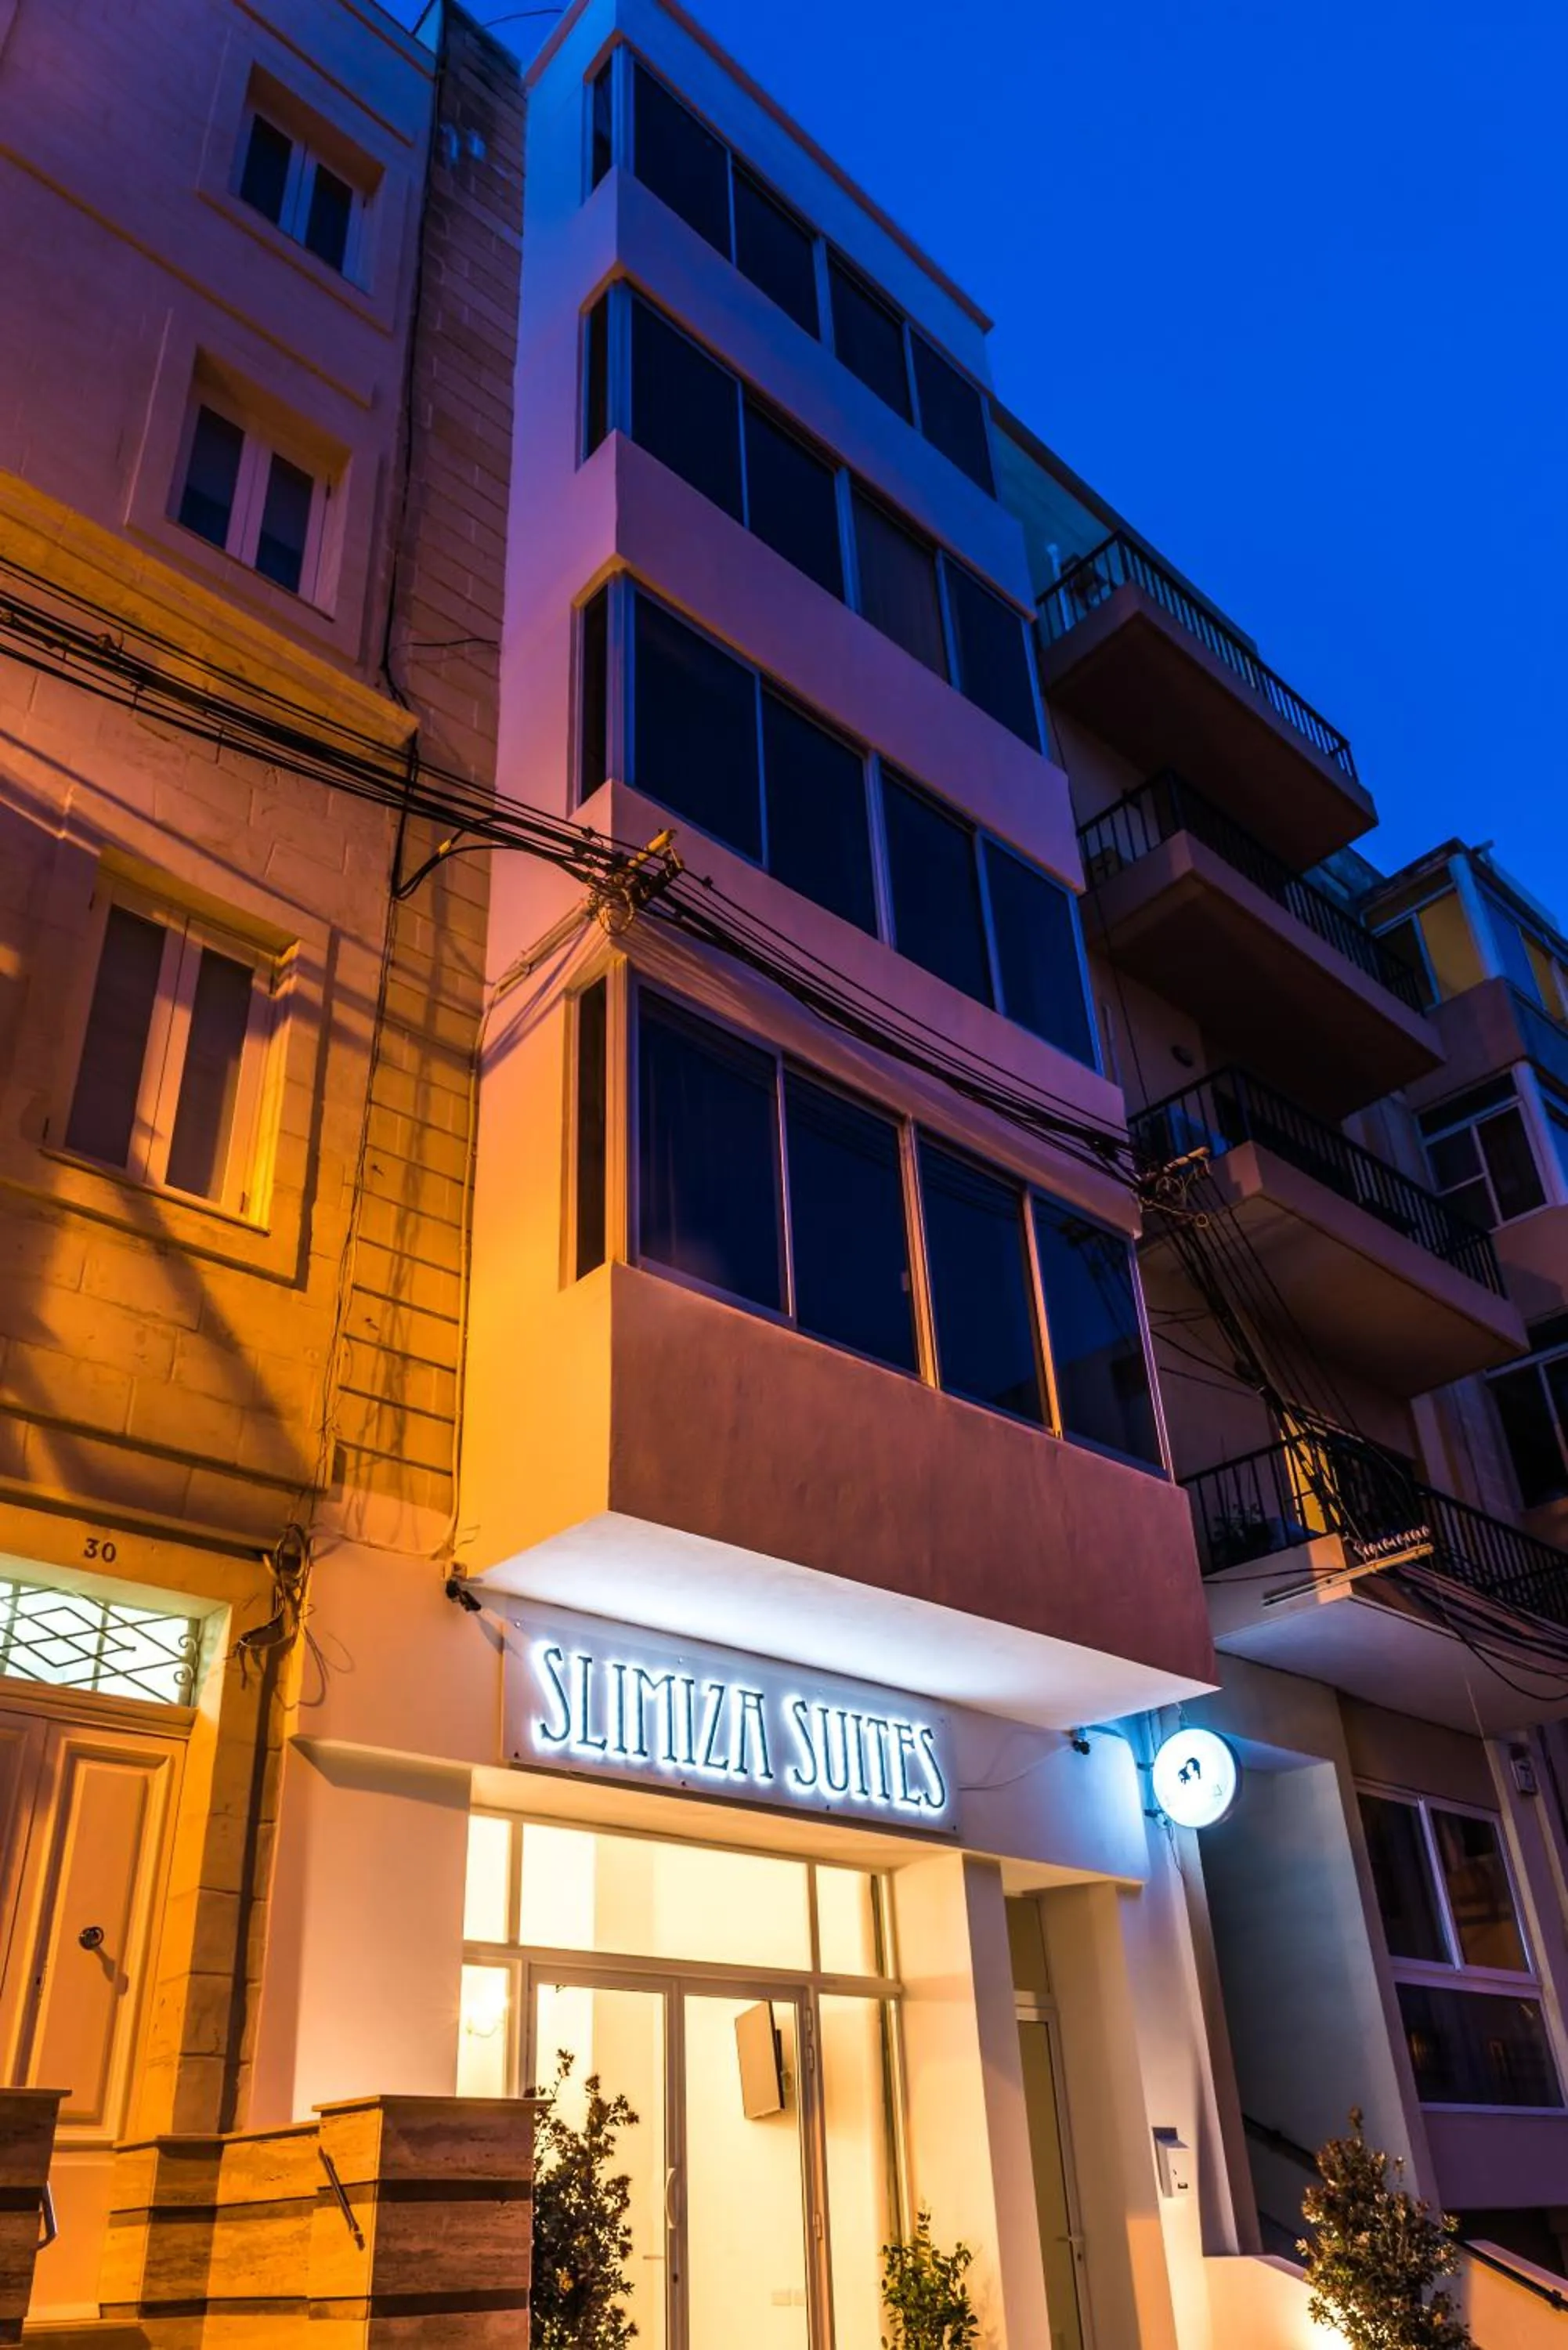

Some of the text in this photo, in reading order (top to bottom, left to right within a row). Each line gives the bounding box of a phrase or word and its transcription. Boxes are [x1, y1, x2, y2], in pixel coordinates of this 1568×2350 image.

[84, 1538, 117, 1564] 30
[539, 1647, 946, 1809] SLIMIZA SUITES
